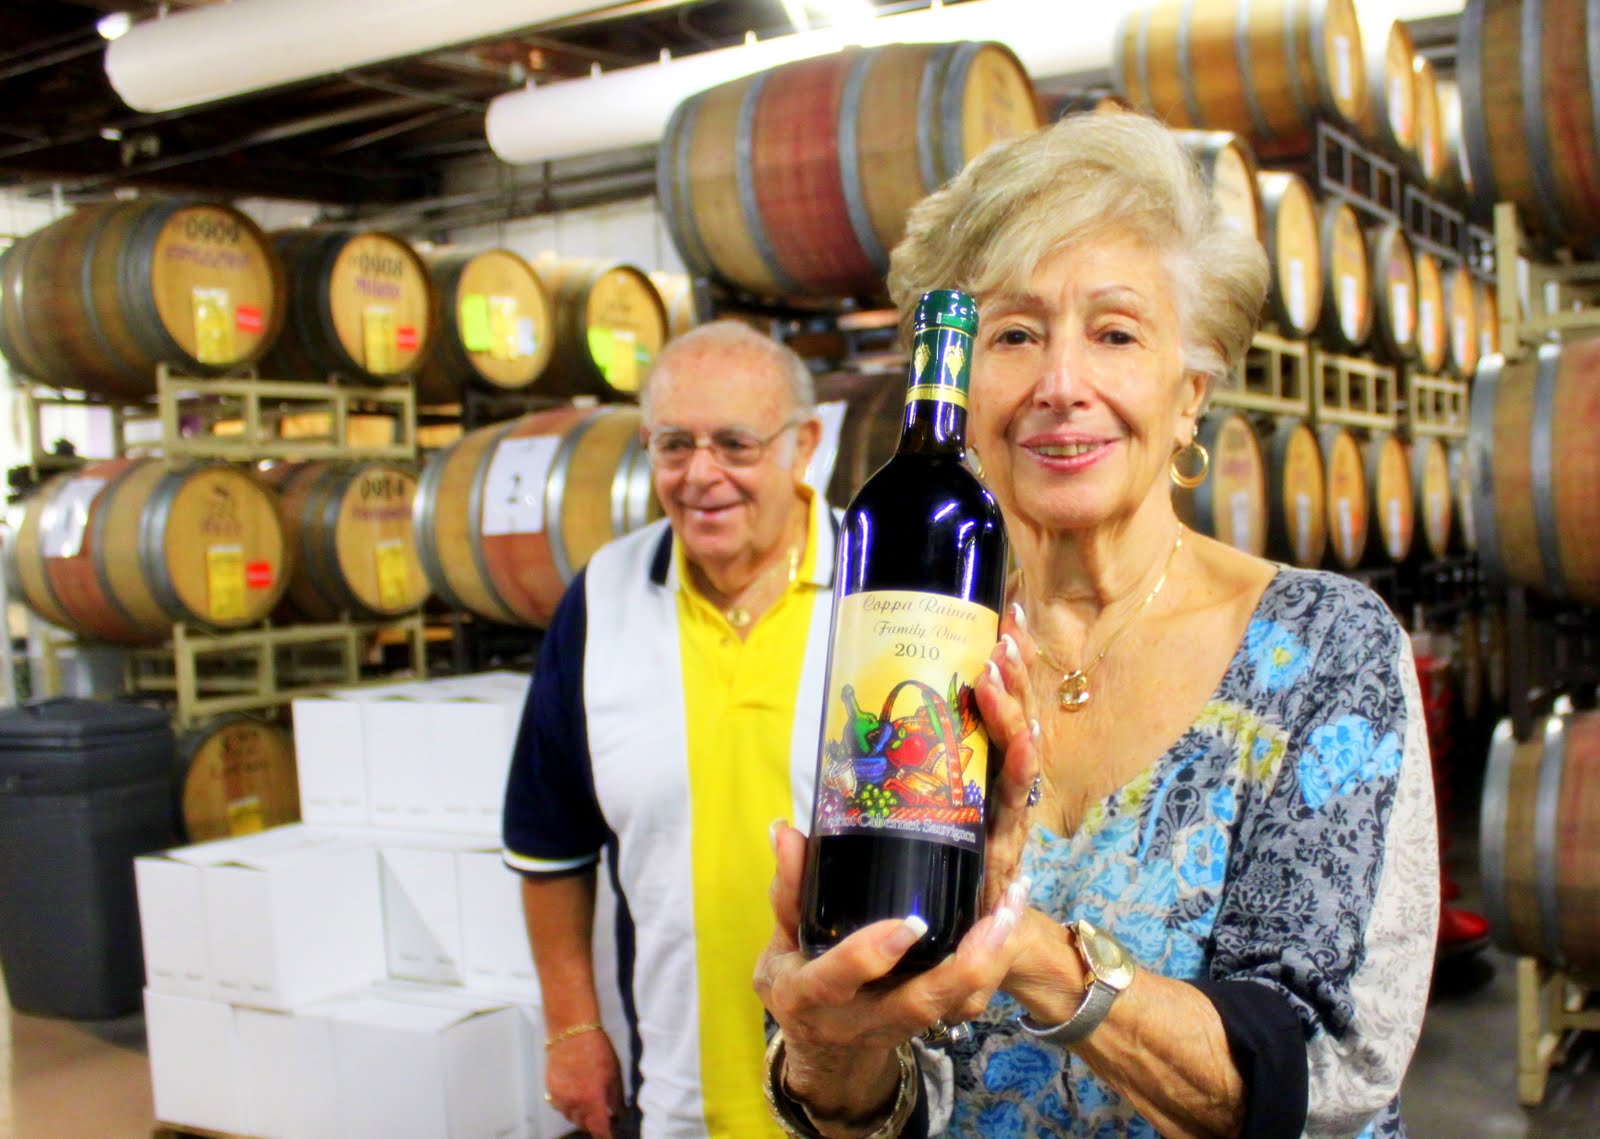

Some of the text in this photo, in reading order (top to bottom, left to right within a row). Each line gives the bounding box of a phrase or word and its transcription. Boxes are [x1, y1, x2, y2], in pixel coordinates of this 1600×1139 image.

[863, 594, 913, 614] Coppa
[874, 620, 927, 640] Family
[895, 643, 940, 661] 2010
[859, 812, 921, 831] Cabernet
[922, 818, 976, 843] Sauvignon
